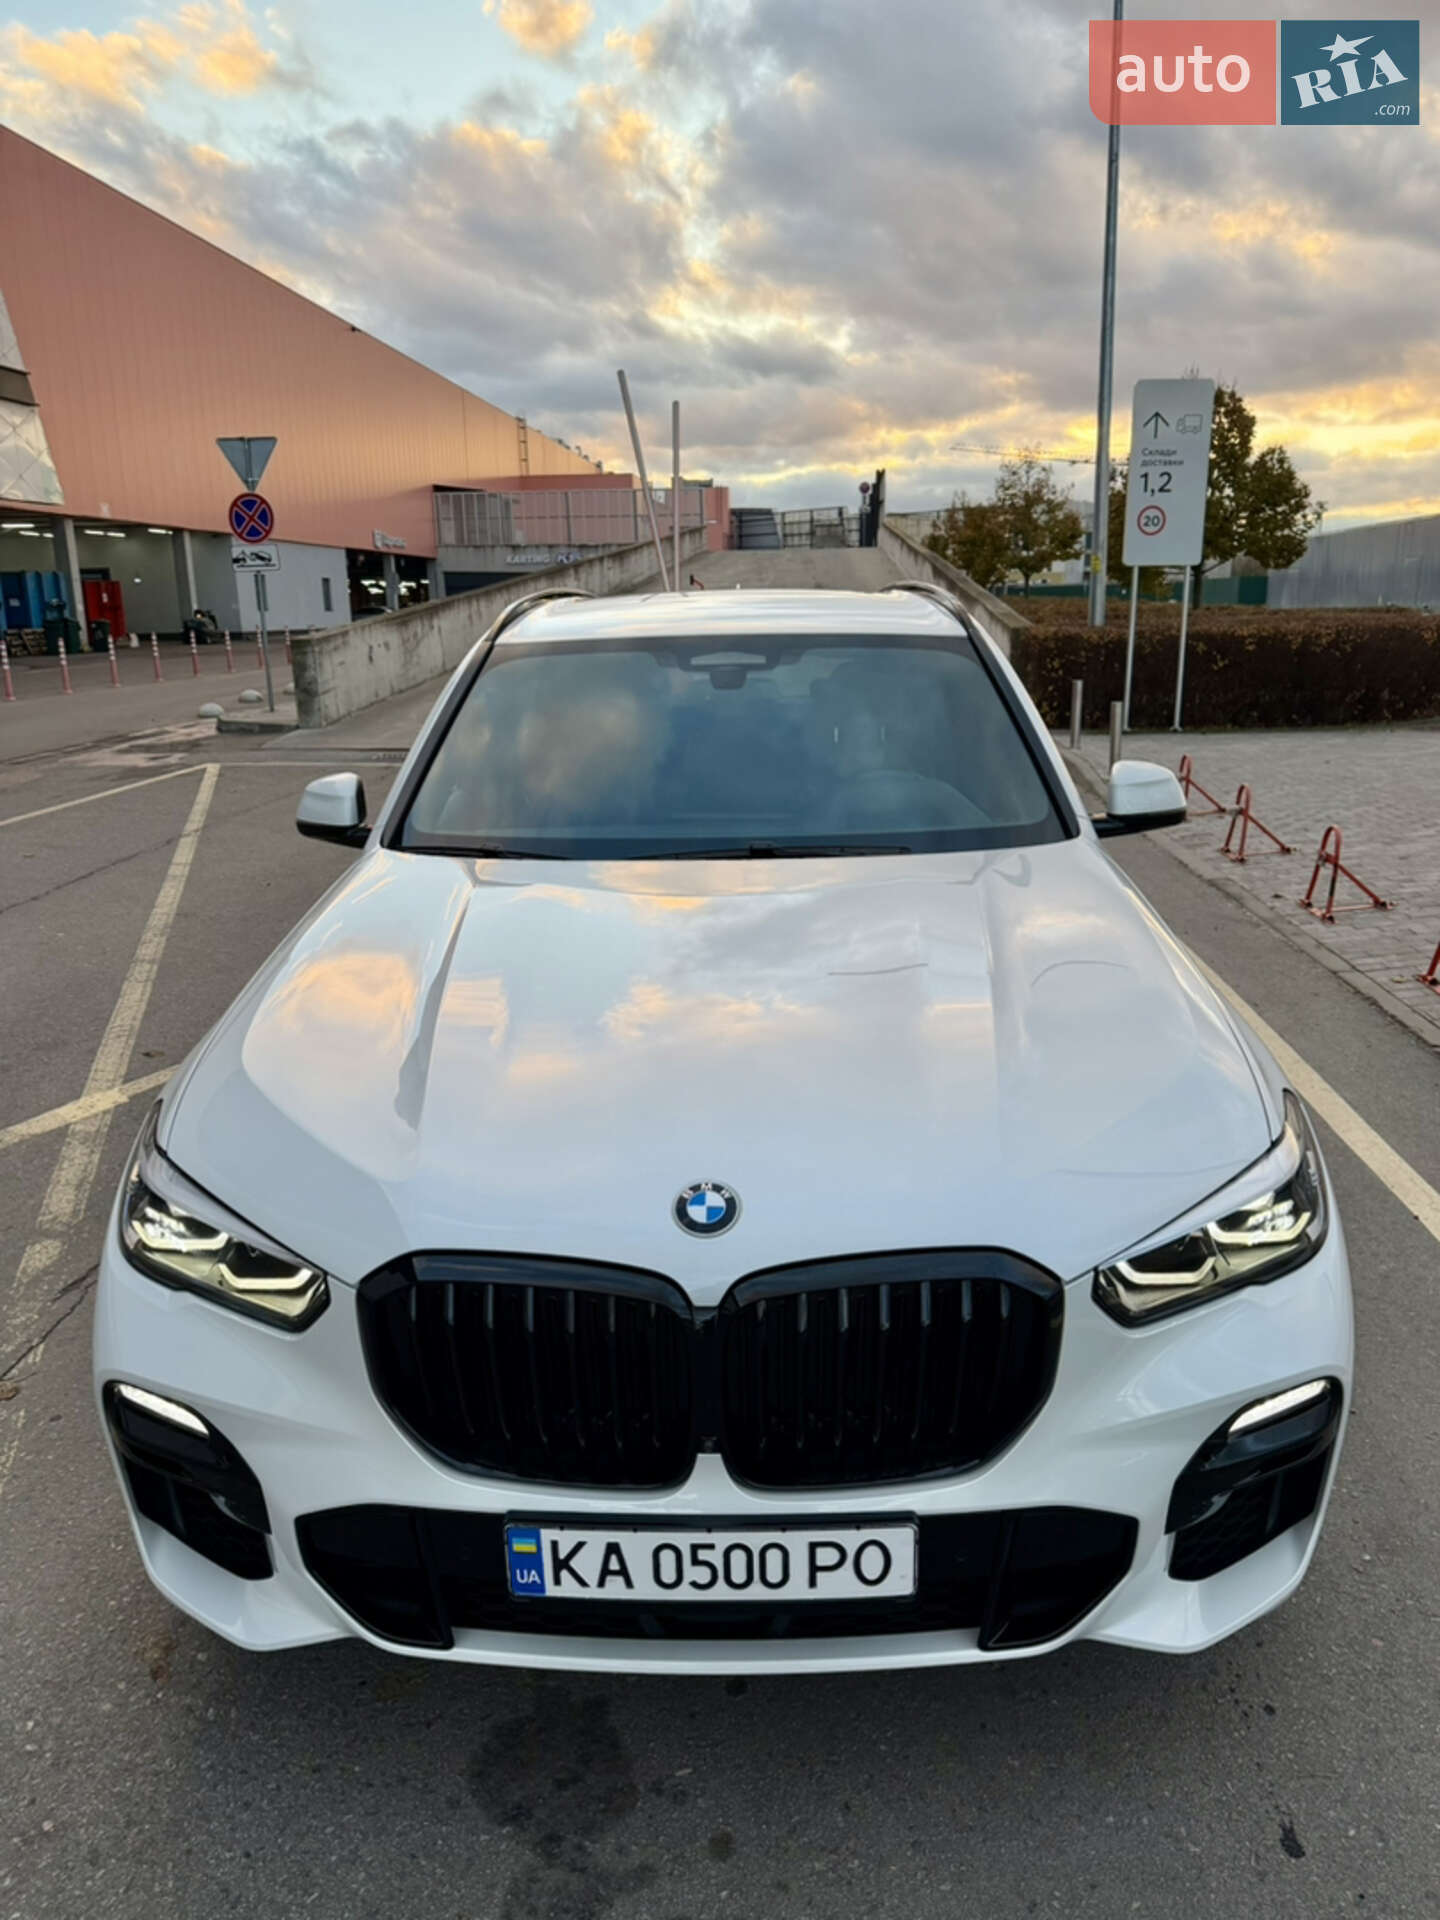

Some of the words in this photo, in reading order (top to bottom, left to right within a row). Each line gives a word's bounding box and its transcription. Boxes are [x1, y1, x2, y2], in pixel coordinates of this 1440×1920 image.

[1139, 470, 1173, 496] 1,2
[1143, 514, 1161, 527] 20
[550, 1540, 634, 1589] KA
[652, 1542, 790, 1590] 0500
[808, 1539, 892, 1589] PO
[516, 1568, 541, 1585] UA
